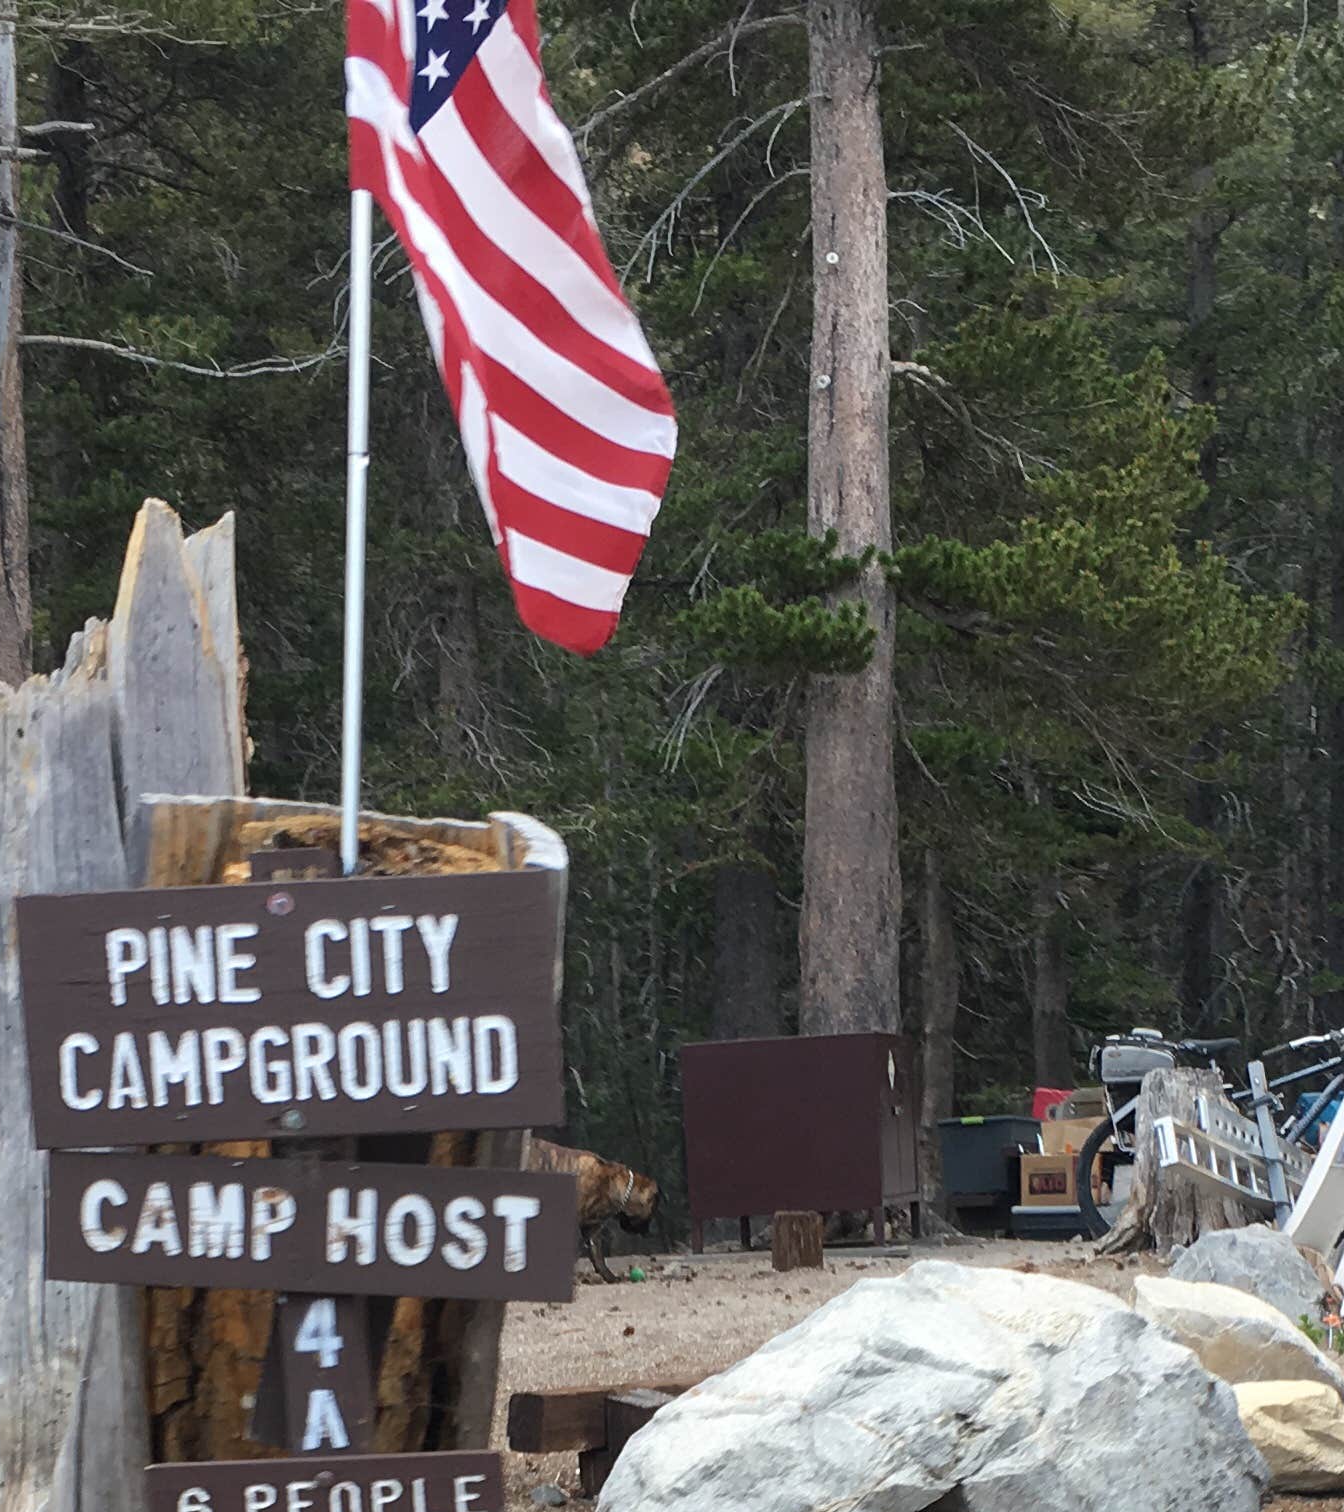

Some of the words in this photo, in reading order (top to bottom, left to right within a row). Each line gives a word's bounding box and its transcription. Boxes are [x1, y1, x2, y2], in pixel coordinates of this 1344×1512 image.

[106, 924, 261, 1005] PINE
[305, 914, 458, 998] CITY
[60, 1015, 517, 1109] CAMPGROUND
[81, 1180, 295, 1260] CAMP
[327, 1188, 539, 1271] HOST
[296, 1301, 341, 1367] 4
[303, 1390, 346, 1449] A
